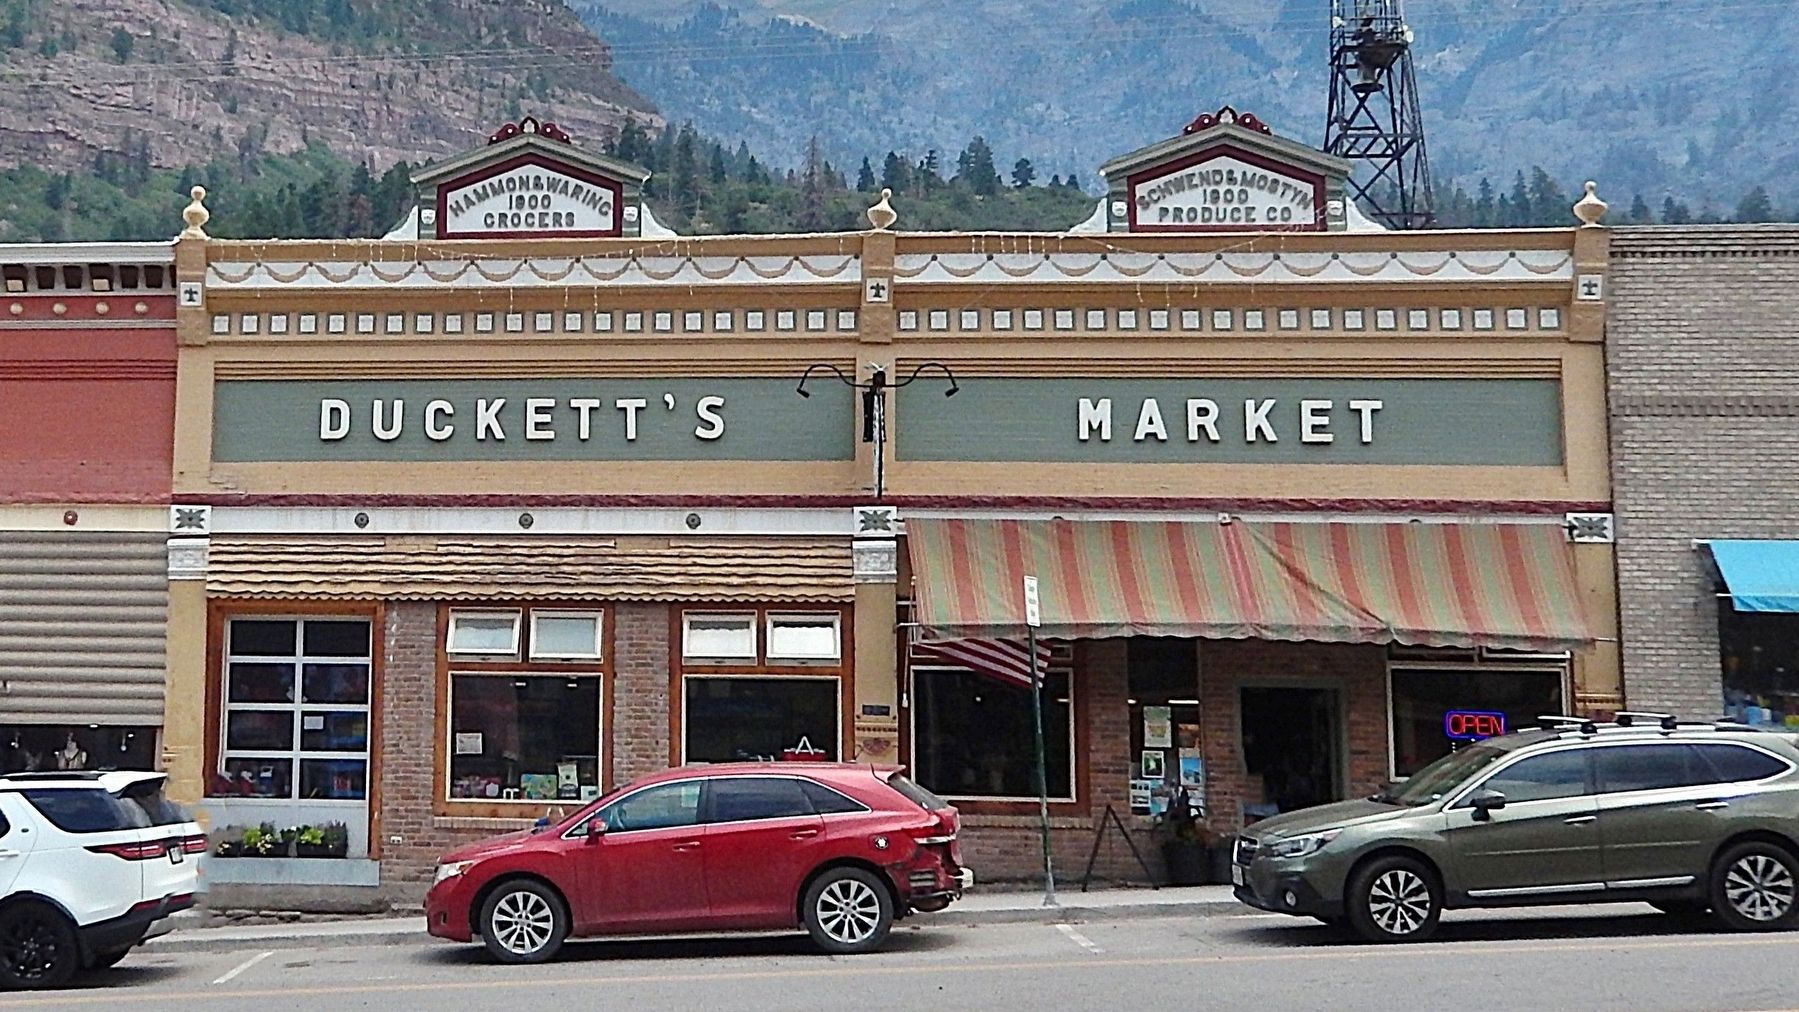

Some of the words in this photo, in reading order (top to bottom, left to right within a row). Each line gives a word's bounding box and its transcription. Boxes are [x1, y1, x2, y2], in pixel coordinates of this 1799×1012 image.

[508, 194, 552, 210] 1900
[1203, 188, 1249, 206] 1900
[483, 211, 575, 228] GROCERS
[1158, 206, 1256, 223] PRODUCE
[1266, 206, 1292, 222] CO
[319, 394, 726, 441] DUCKETT'S
[1077, 397, 1384, 443] MARKET
[1448, 714, 1505, 736] OPEN
